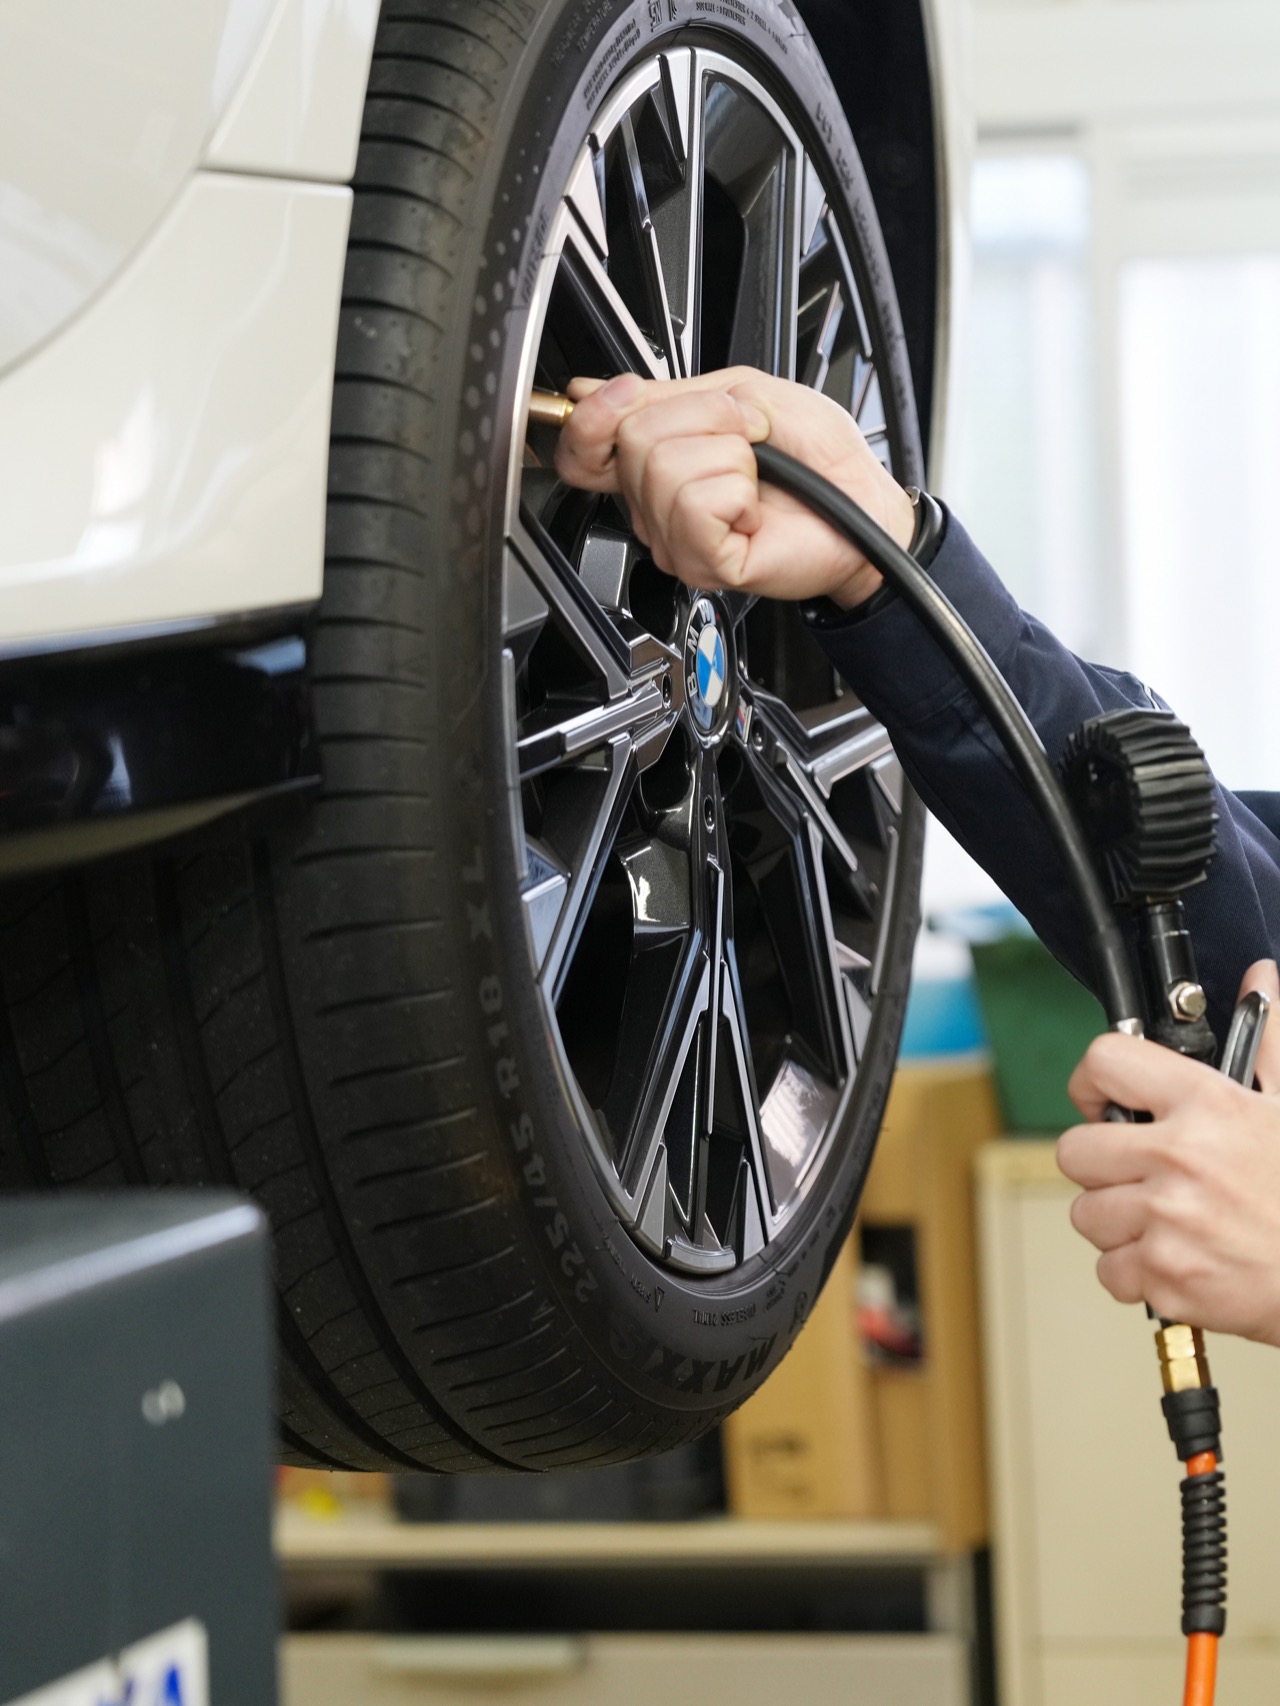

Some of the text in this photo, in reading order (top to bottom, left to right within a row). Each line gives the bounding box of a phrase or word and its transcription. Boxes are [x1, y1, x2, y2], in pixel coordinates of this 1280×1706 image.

[479, 975, 520, 1099] R18
[509, 1112, 600, 1303] 225/45
[609, 1318, 778, 1394] MAXXIS
